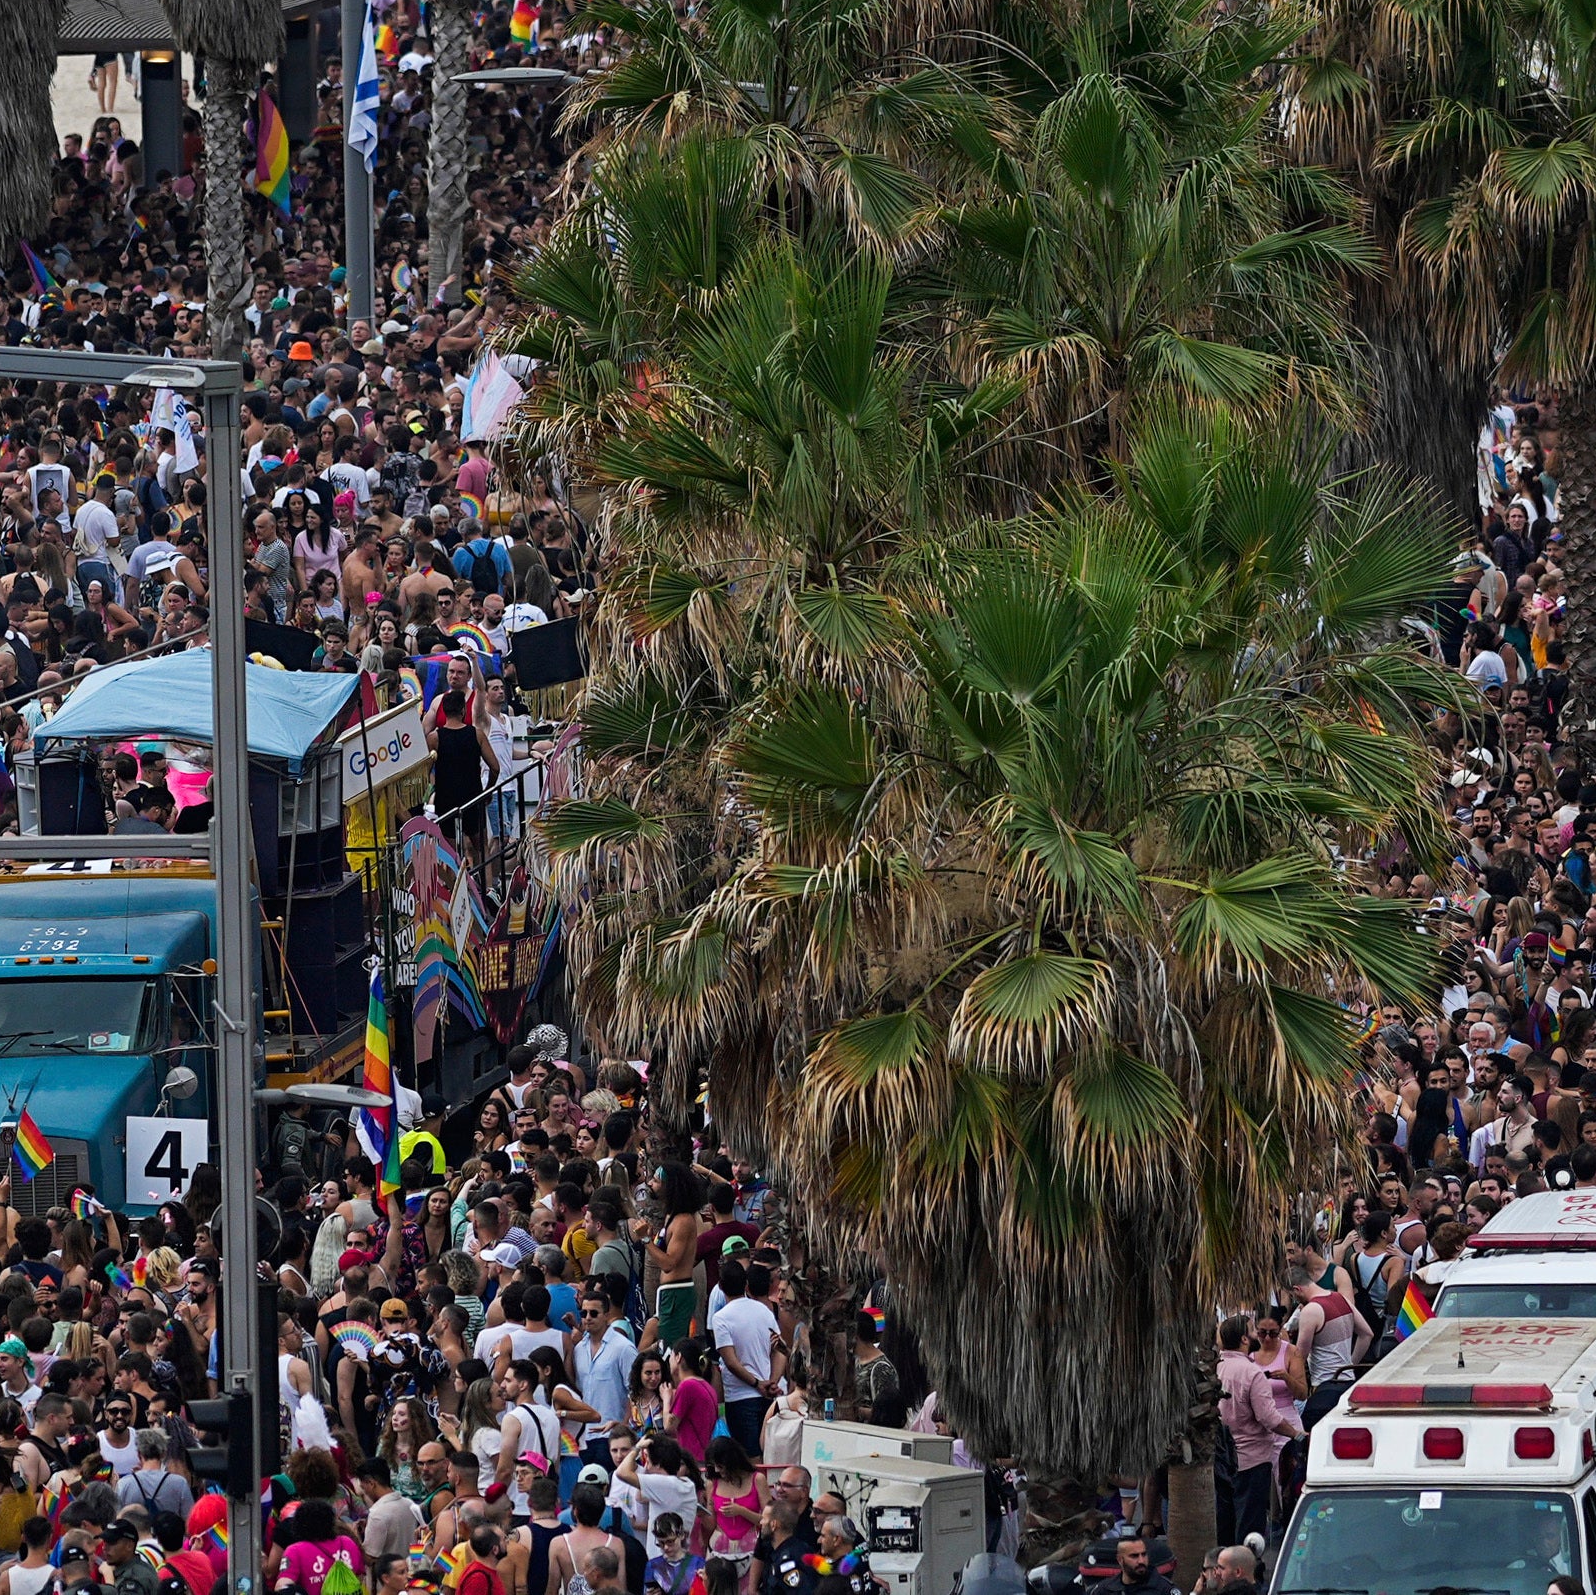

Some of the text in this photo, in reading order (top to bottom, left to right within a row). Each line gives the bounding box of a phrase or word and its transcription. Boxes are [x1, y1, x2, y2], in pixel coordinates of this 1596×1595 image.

[349, 729, 412, 775] Google
[392, 886, 416, 917] WHO
[394, 924, 416, 956] YOU
[396, 961, 418, 986] ARE!
[480, 935, 546, 992] ONE NIGHT
[144, 1130, 189, 1195] 4
[1460, 1324, 1583, 1336] 2613
[309, 1574, 325, 1584] TikT
